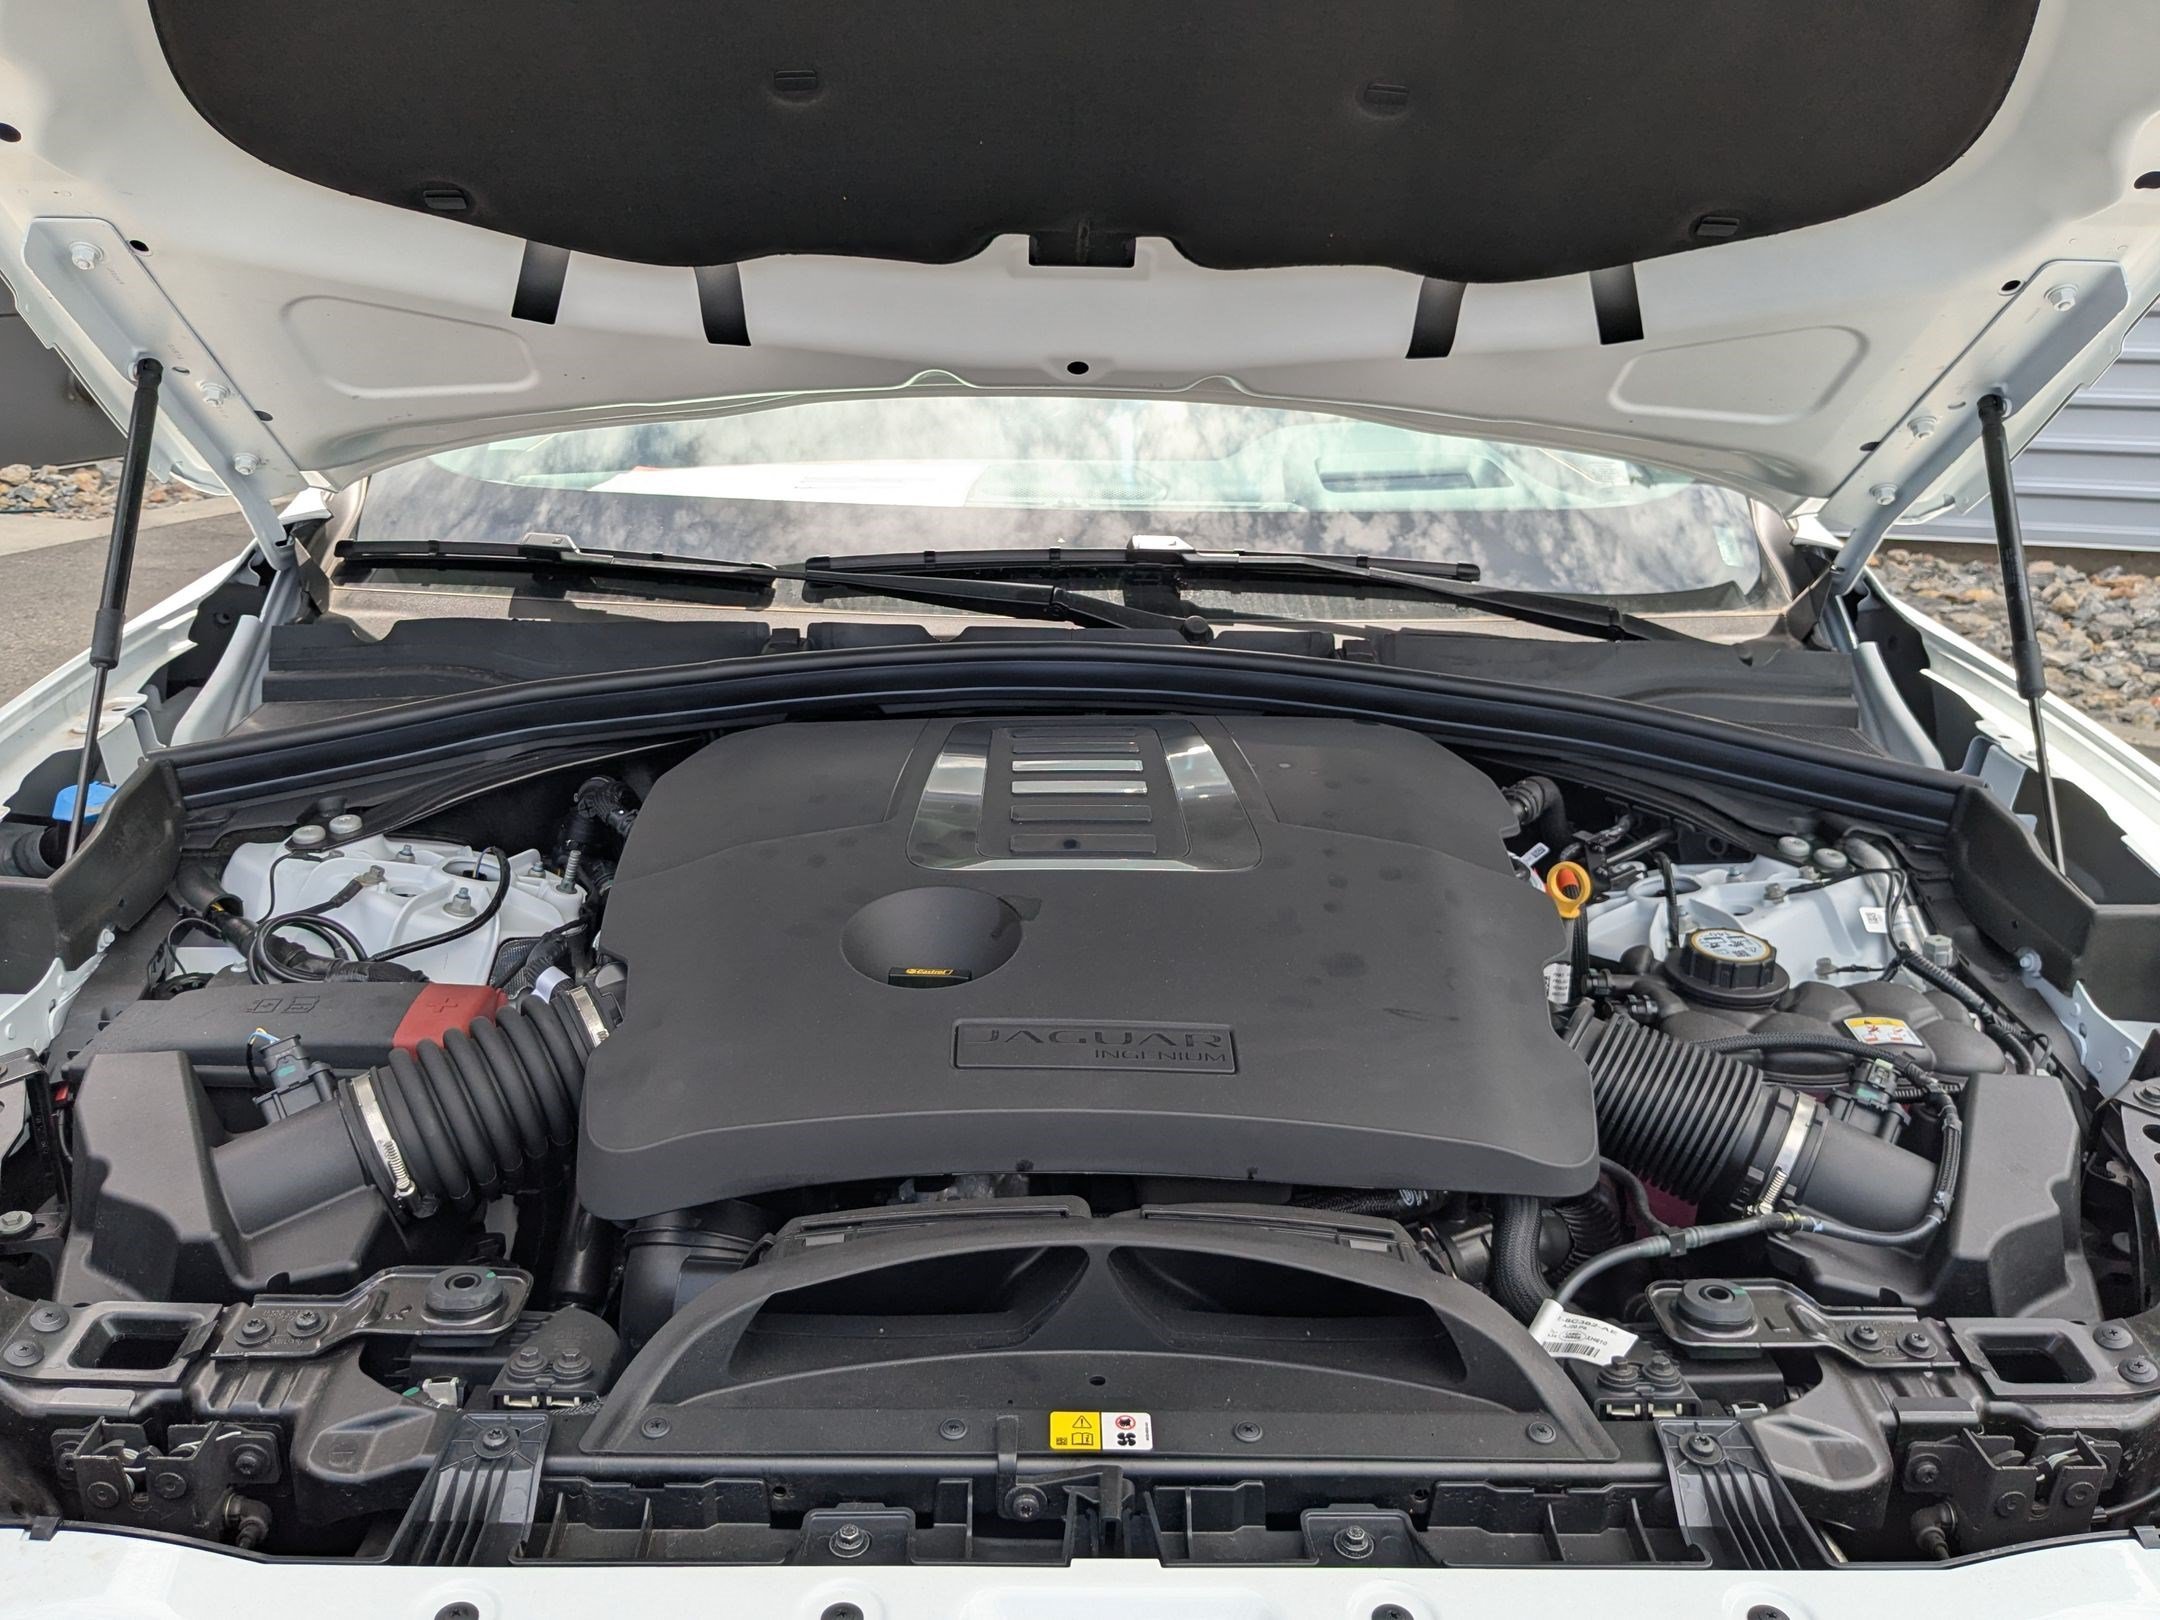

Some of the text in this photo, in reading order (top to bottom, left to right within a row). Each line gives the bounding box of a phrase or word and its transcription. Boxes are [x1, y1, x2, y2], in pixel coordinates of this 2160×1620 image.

[915, 968, 952, 976] Castrol
[966, 1029, 1223, 1048] JAGUAR
[1095, 1049, 1226, 1062] INGENIUM
